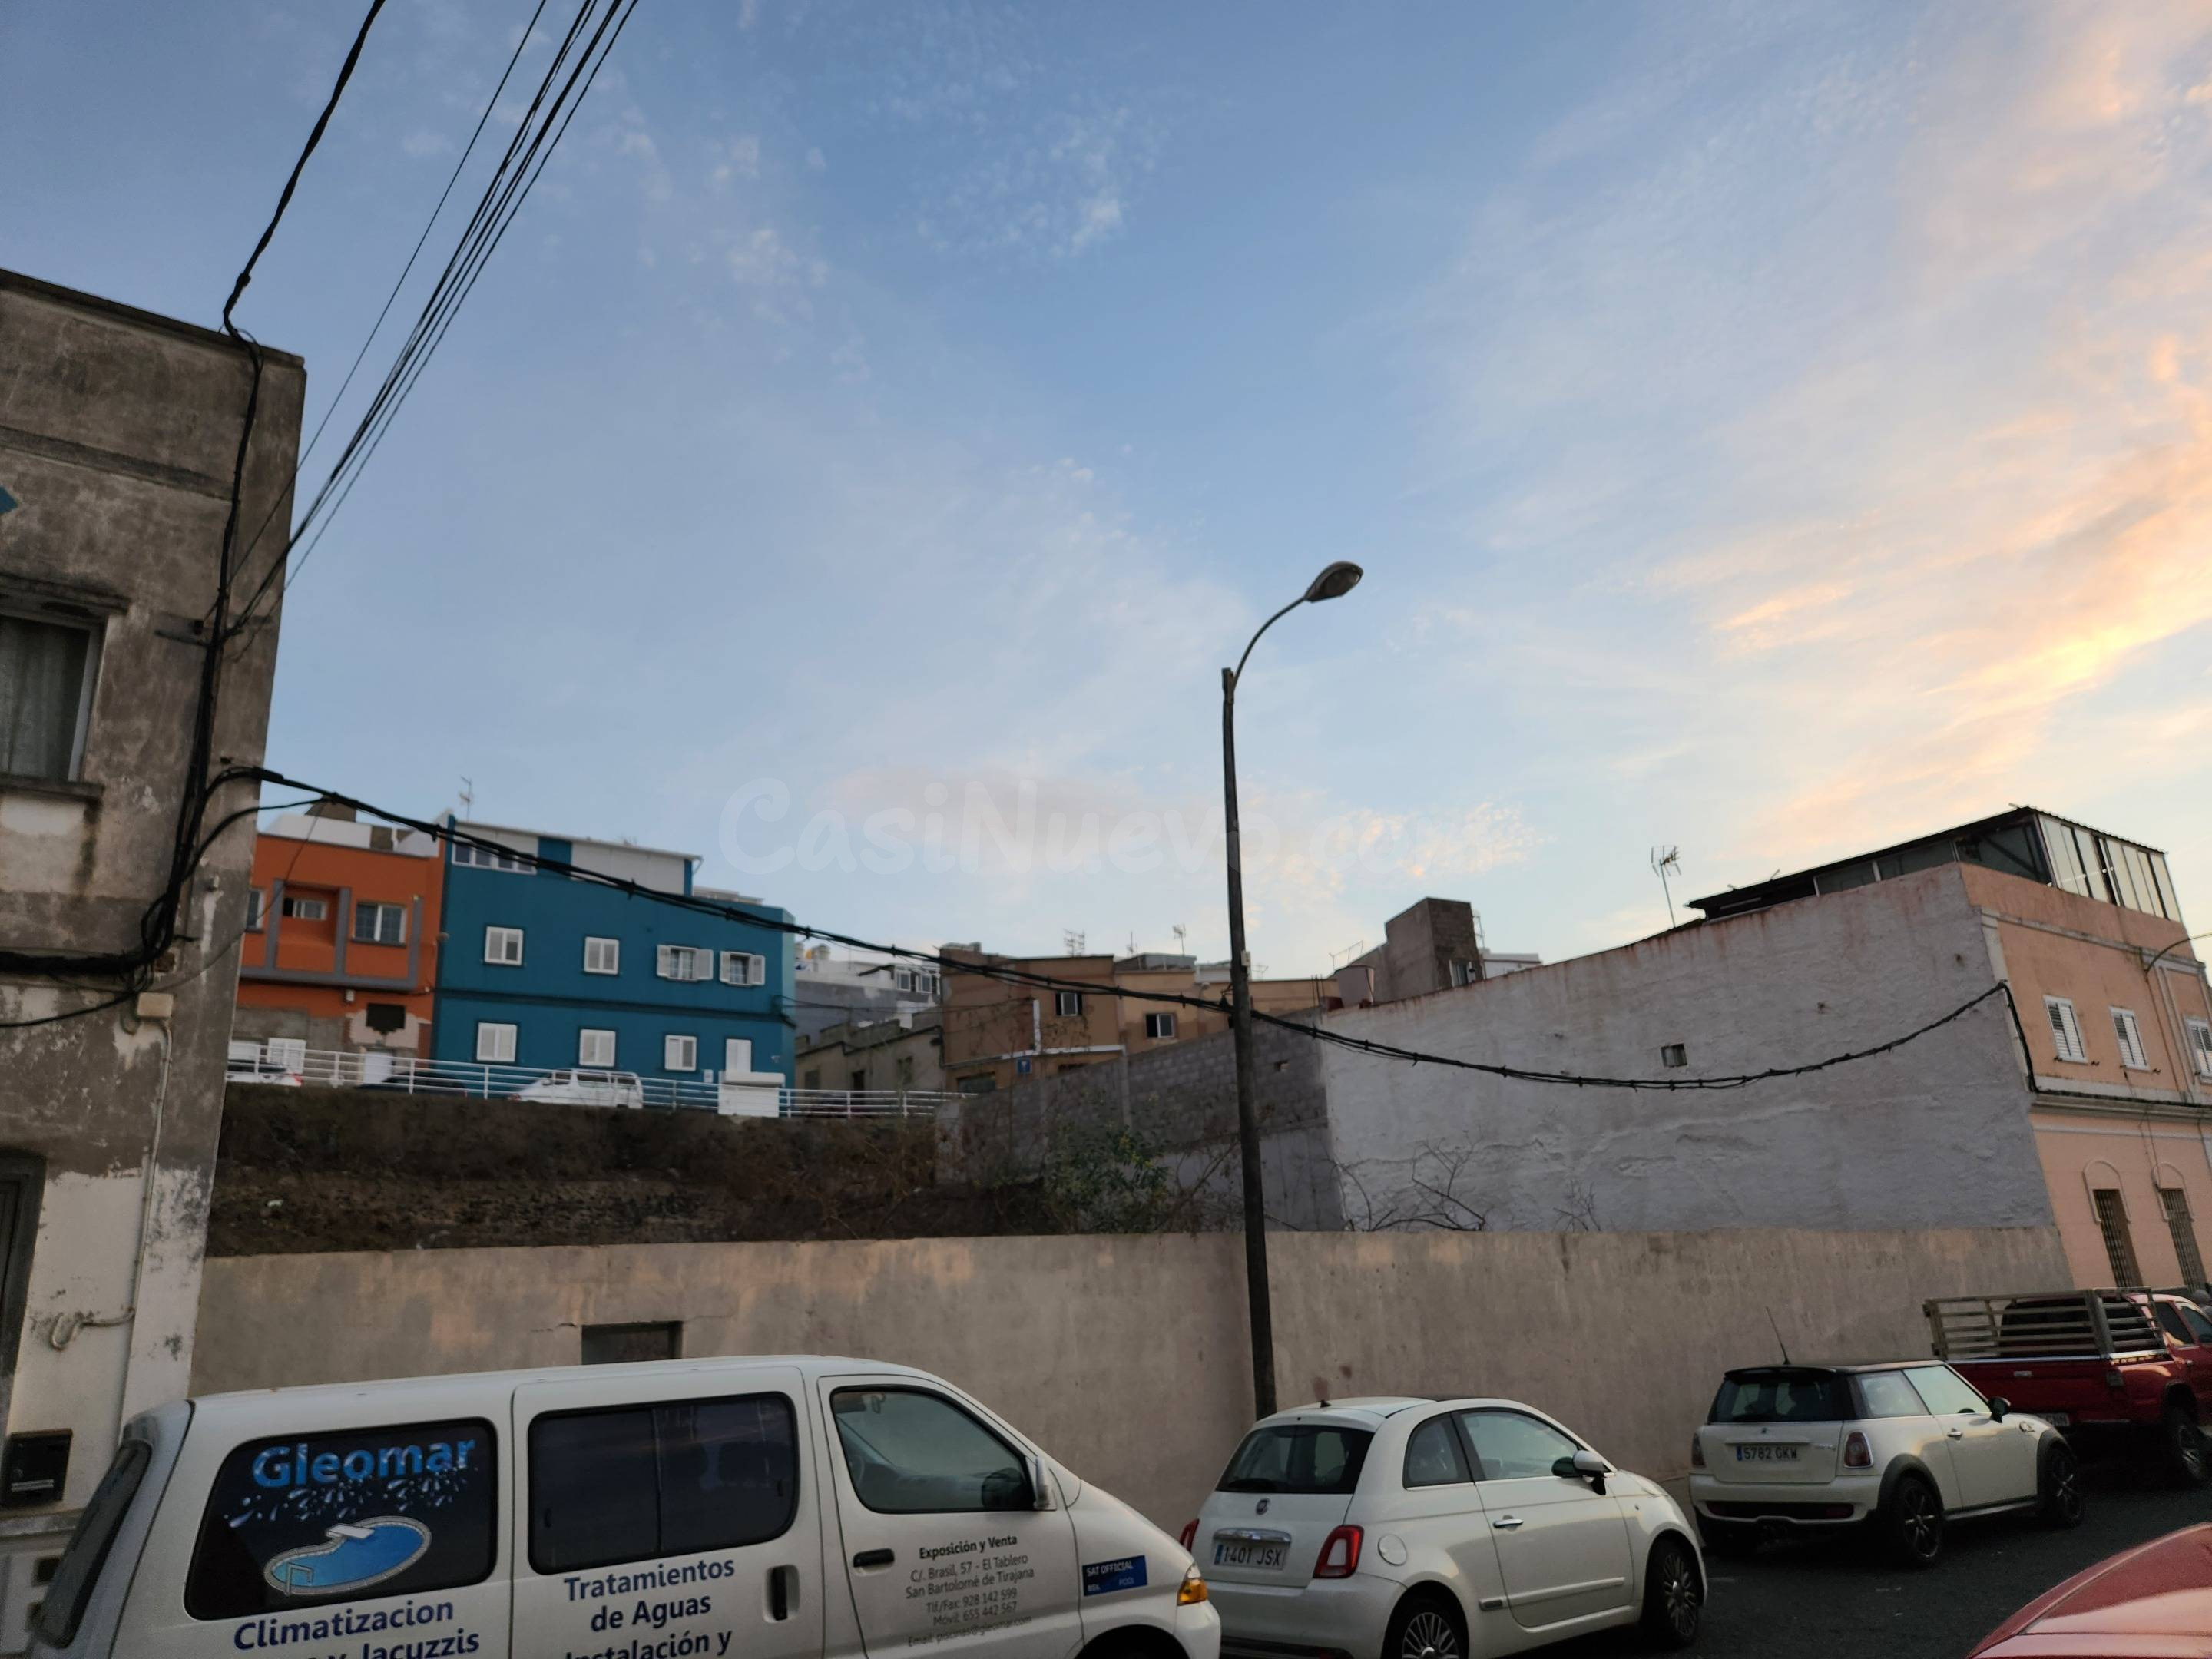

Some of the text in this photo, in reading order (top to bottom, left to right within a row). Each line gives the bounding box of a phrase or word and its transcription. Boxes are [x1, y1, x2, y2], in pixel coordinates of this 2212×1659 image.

[252, 1439, 475, 1488] Gleomar
[1743, 1446, 1797, 1459] 5782 GKW
[919, 1535, 1018, 1560] Exposición y Venta
[1224, 1547, 1282, 1566] 1401 JSX
[960, 1561, 972, 1575] 57
[982, 1558, 992, 1571] El
[993, 1555, 1028, 1569] Tablero
[564, 1559, 735, 1601] Tratamientos
[906, 1568, 1035, 1599] San Bartolomé de Tirajana
[591, 1595, 711, 1631] de Aguas
[963, 1593, 979, 1608] 928
[982, 1590, 998, 1604] 142
[233, 1600, 454, 1650] Climatizacion
[963, 1608, 979, 1621] 655
[363, 1628, 480, 1659] Jacuzzis
[565, 1630, 733, 1659] talación y
